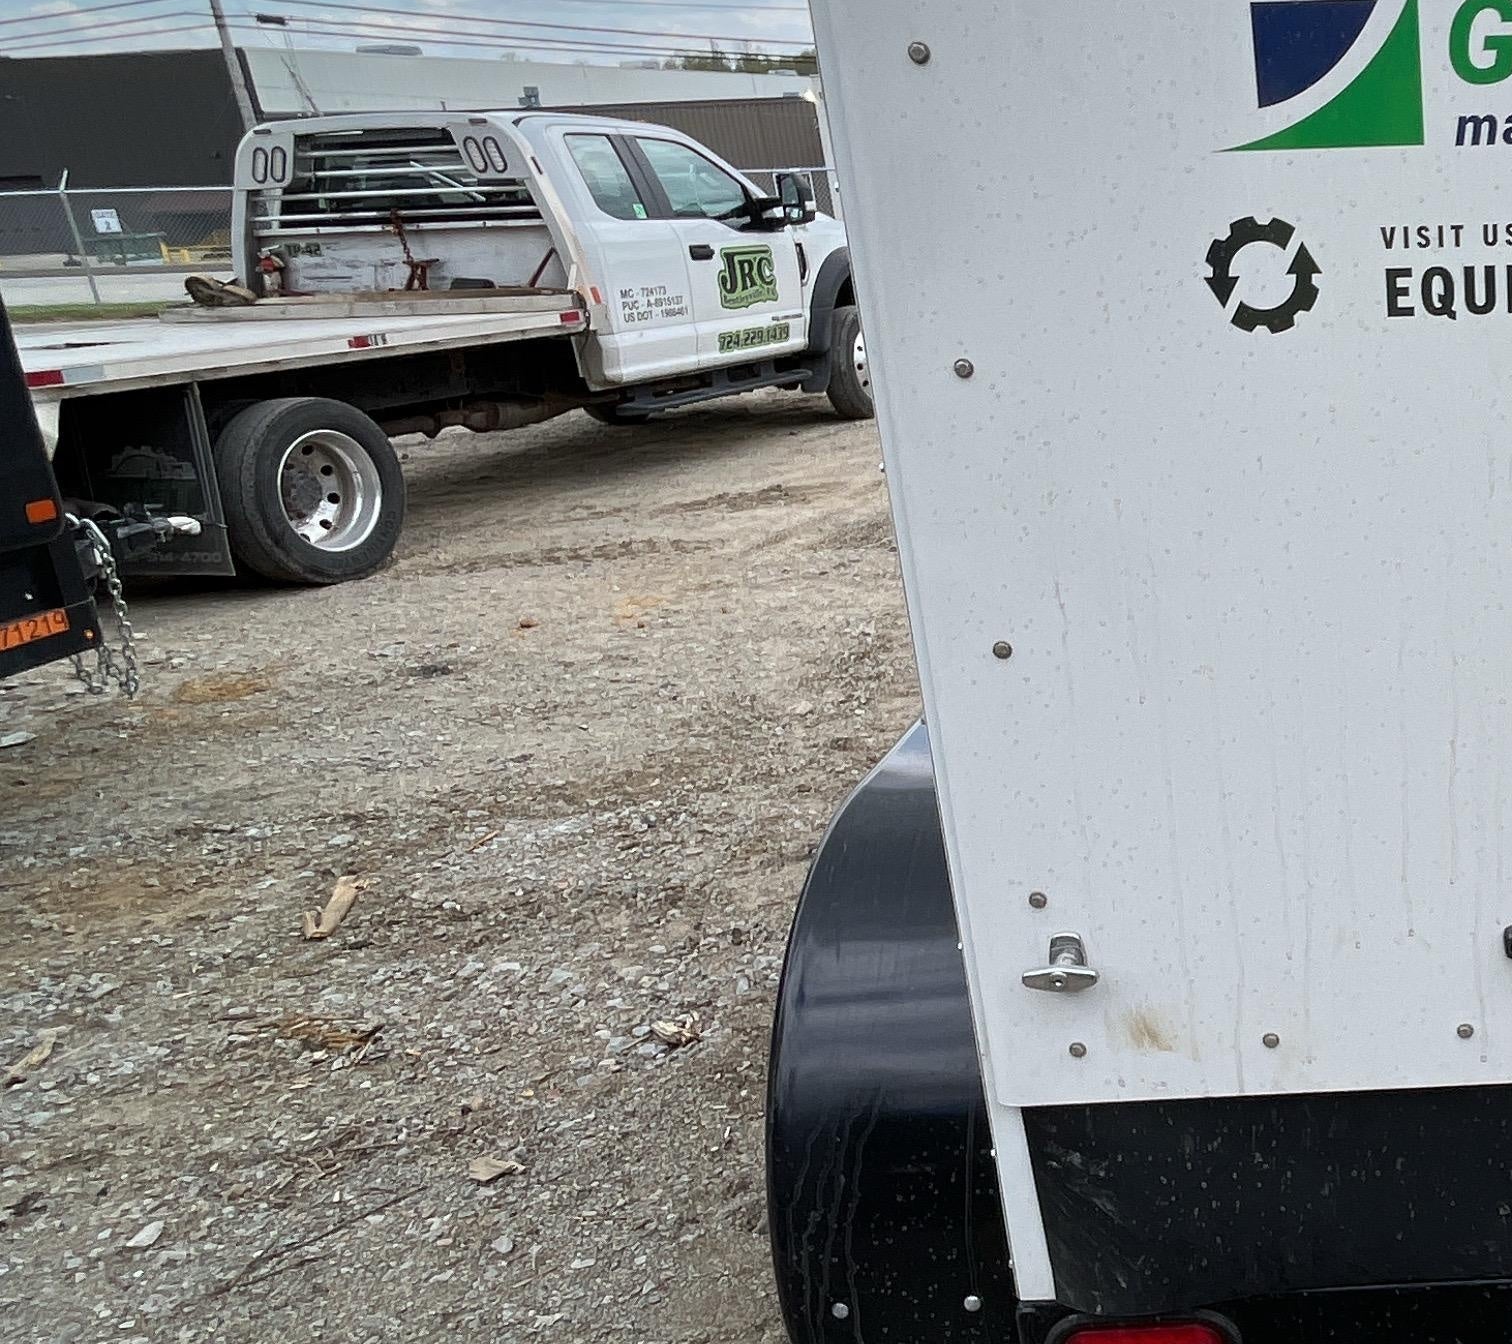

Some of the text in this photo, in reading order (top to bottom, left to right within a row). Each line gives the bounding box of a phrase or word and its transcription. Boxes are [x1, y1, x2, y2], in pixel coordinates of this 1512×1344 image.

[1380, 223, 1465, 250] VISIT
[721, 249, 775, 294] JRC
[620, 288, 635, 299] MC
[622, 300, 640, 311] PUC
[624, 311, 636, 323] US
[637, 310, 653, 321] DOT
